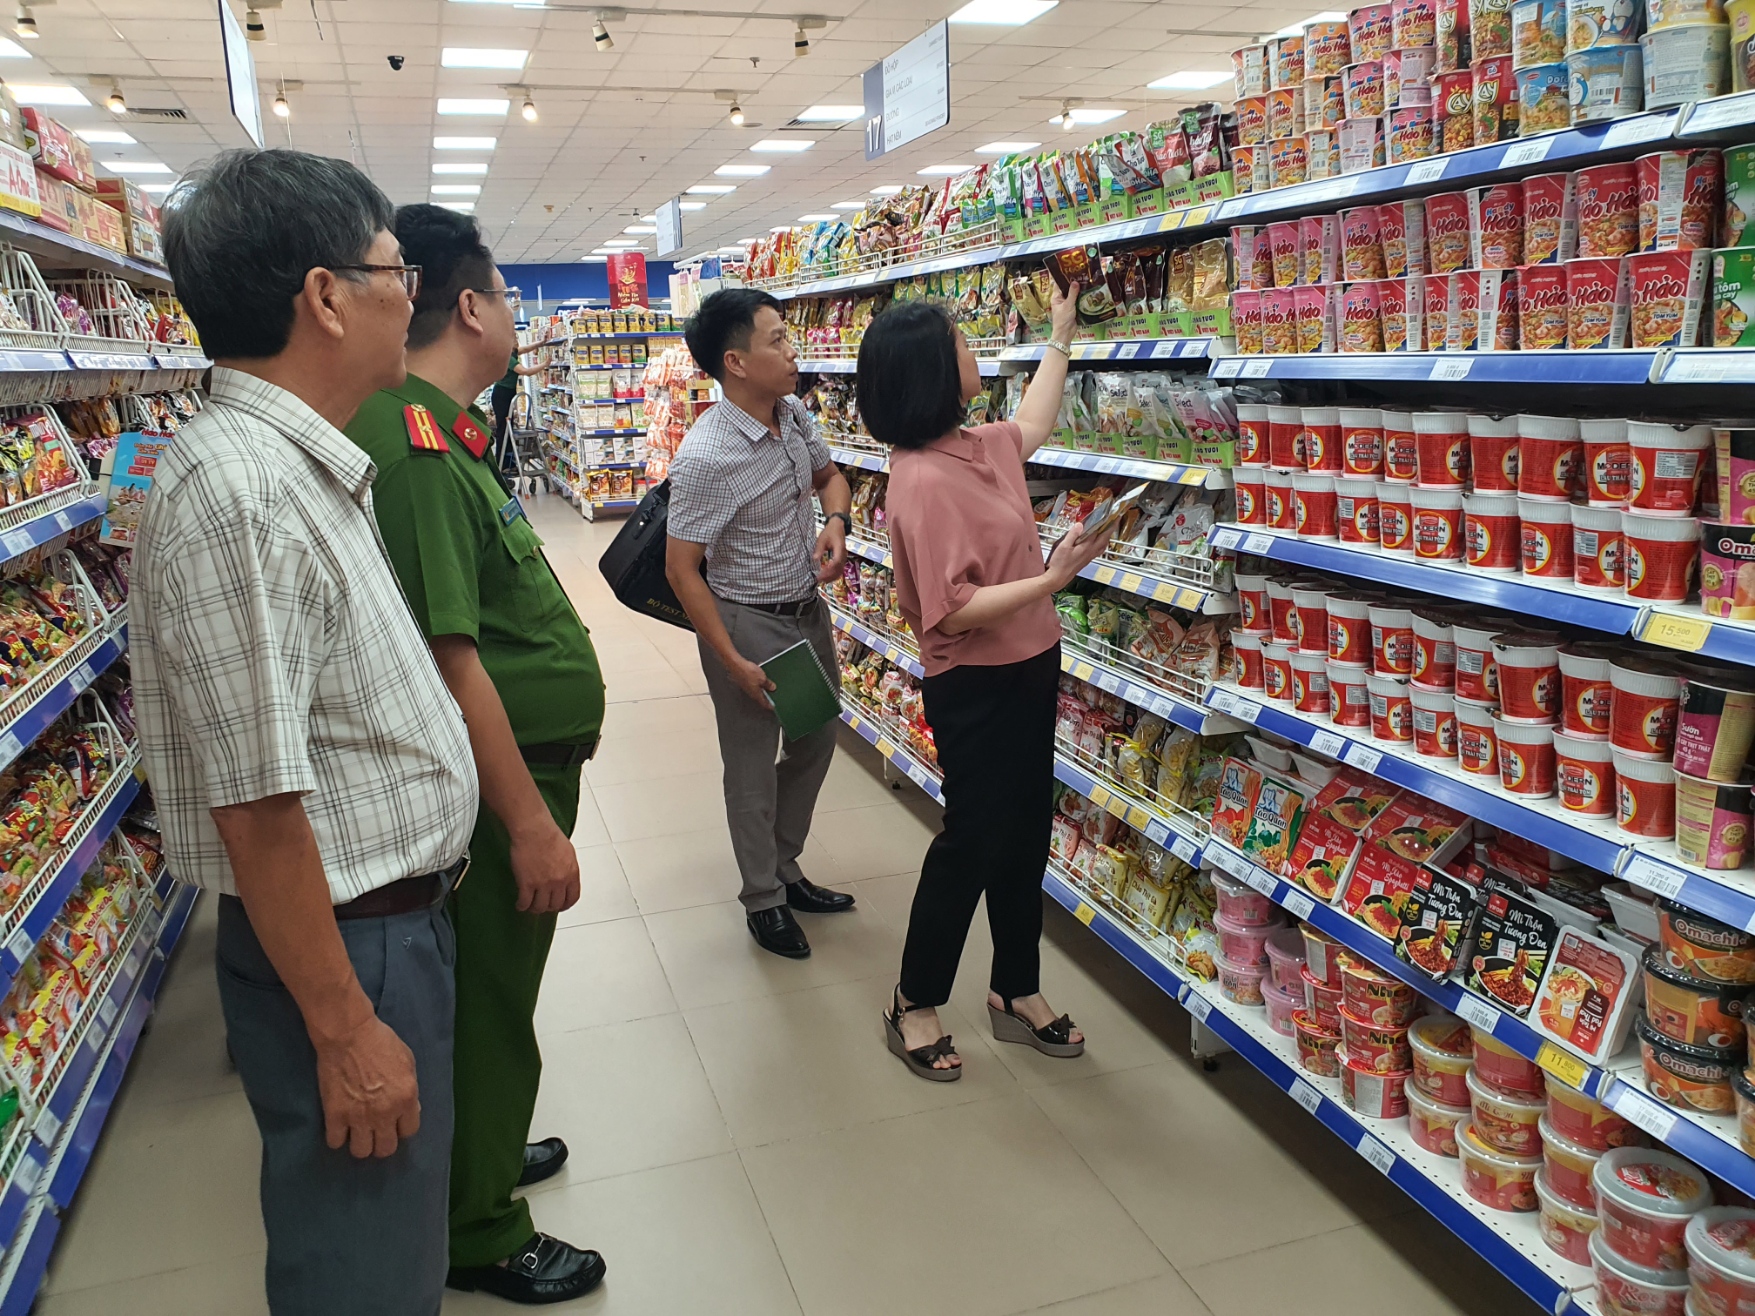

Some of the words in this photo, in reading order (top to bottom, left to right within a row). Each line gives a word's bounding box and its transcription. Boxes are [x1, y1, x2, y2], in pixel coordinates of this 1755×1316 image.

[867, 115, 882, 152] 17
[1061, 250, 1083, 267] SG
[1576, 281, 1614, 307] Hảo
[1642, 275, 1685, 303] Hảo
[1348, 442, 1380, 451] MODERN
[1325, 841, 1348, 855] Spaghetti
[1384, 875, 1410, 891] Spaghetti
[1417, 877, 1430, 888] VIFON
[1433, 882, 1445, 897] Mì
[1445, 886, 1461, 903] Trộn
[1428, 893, 1448, 917] Tương
[1448, 903, 1463, 919] Đen
[1489, 903, 1504, 914] VIFON
[1508, 909, 1524, 924] Mì
[1524, 914, 1543, 931] Trộn
[1503, 921, 1528, 945] Tương
[1529, 932, 1547, 949] Đen
[1675, 918, 1739, 947] Omachi
[1659, 1051, 1722, 1080] Omachi
